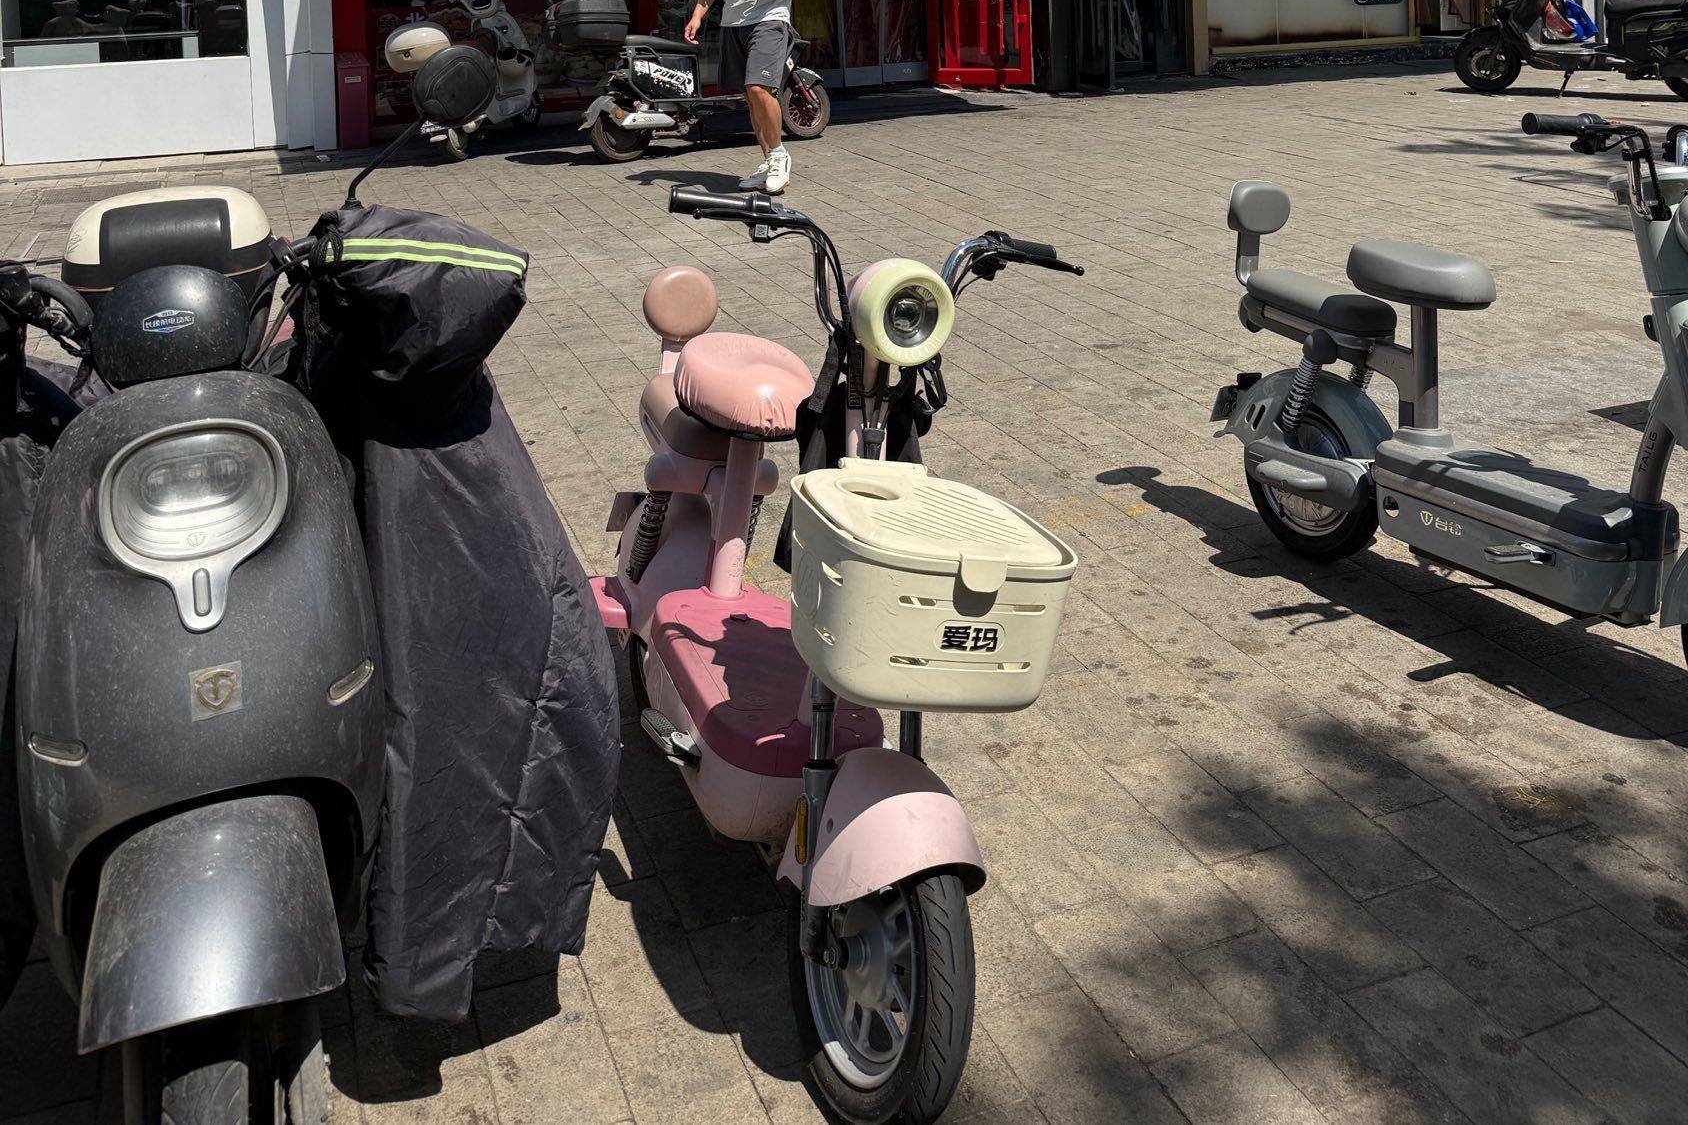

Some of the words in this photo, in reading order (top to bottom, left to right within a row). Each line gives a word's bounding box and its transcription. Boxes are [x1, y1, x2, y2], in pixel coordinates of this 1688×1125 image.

[652, 67, 693, 93] POWER
[1638, 431, 1658, 473] TAILG
[940, 625, 999, 653] 爱玛
